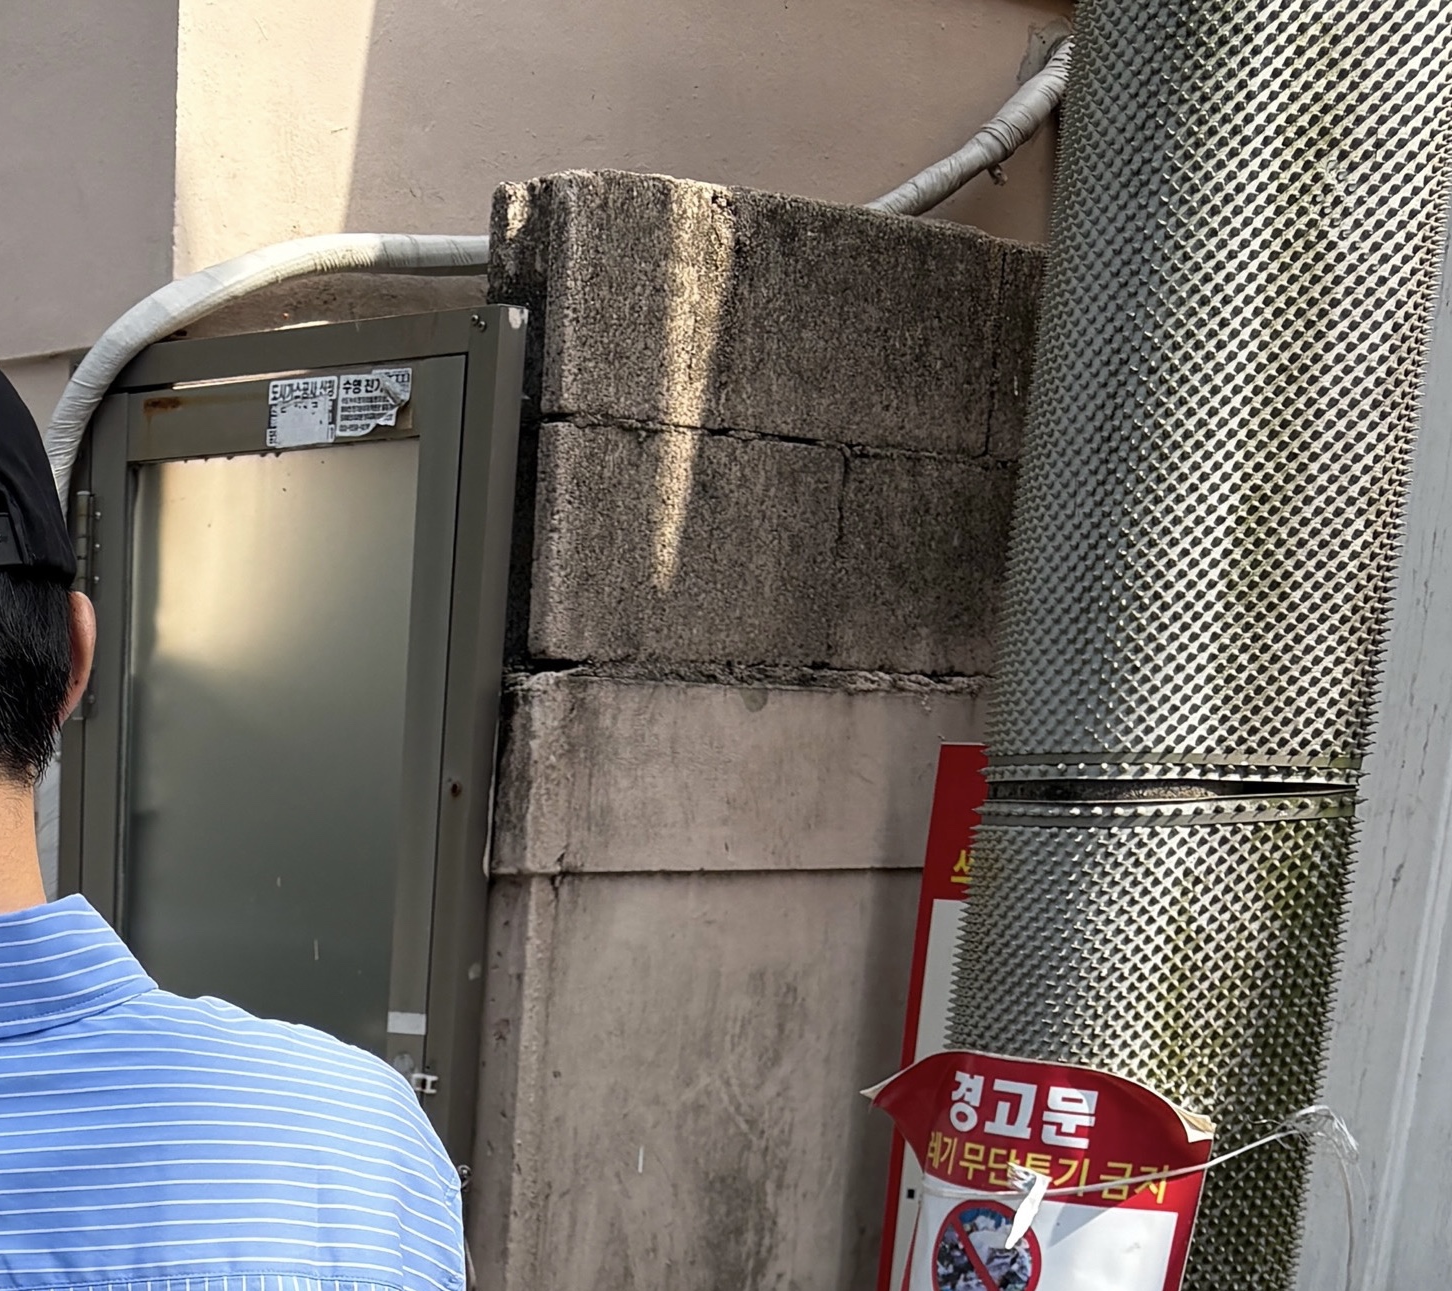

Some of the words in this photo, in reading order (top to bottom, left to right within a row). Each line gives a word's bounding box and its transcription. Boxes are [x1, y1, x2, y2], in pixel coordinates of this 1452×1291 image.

[343, 380, 361, 395] 수영
[949, 1071, 1099, 1149] 경고문
[928, 1131, 958, 1175] 레기
[959, 1142, 1090, 1196] 무단투기
[1099, 1160, 1171, 1204] 금지
